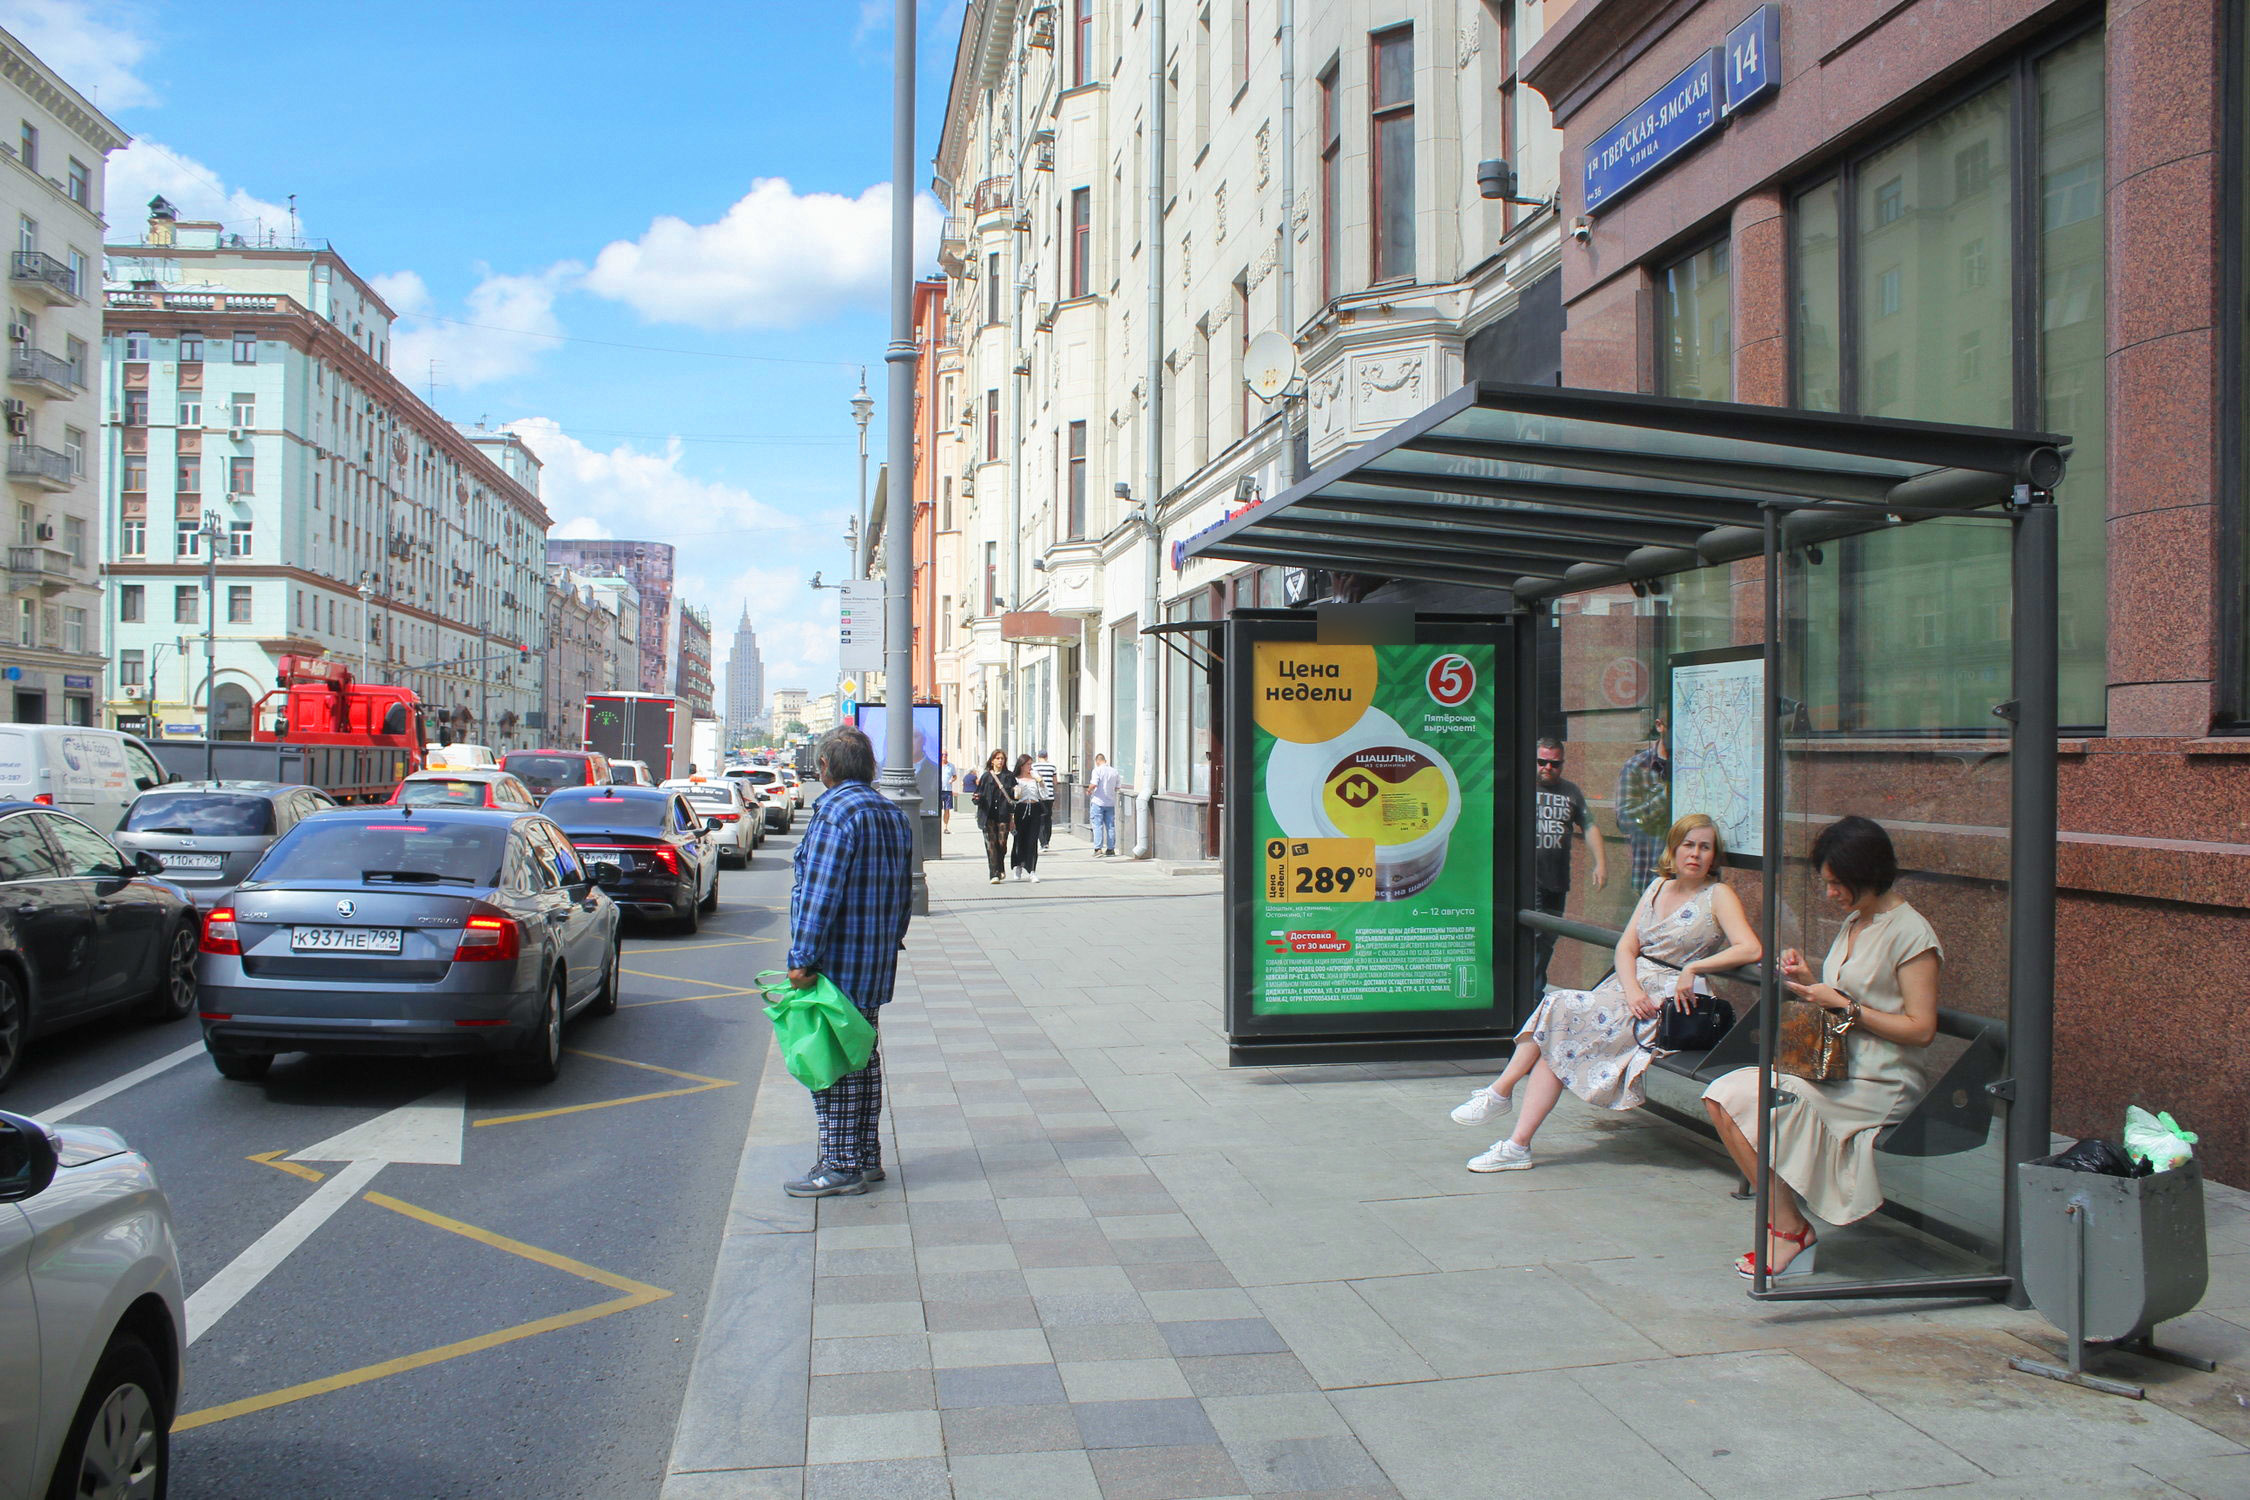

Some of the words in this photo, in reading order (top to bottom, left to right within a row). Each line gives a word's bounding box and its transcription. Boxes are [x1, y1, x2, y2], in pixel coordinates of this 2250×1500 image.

[1733, 33, 1758, 85] 14
[1602, 72, 1708, 171] ТВЕРСКАЯ-ЯМСКАЯ
[1630, 140, 1659, 167] УЛИЦА
[1280, 660, 1339, 680] Цена
[1266, 683, 1352, 701] недели
[1424, 714, 1476, 723] Пятёрочка
[1424, 724, 1476, 733] выручает!
[1356, 754, 1416, 763] ШАШЛЫК
[1296, 866, 1356, 893] 289
[1358, 868, 1373, 878] 90
[1430, 908, 1440, 916] 12
[1441, 908, 1475, 916] августа
[298, 929, 367, 947] К937НЕ
[371, 930, 397, 943] 799
[1459, 966, 1474, 997] 18+
